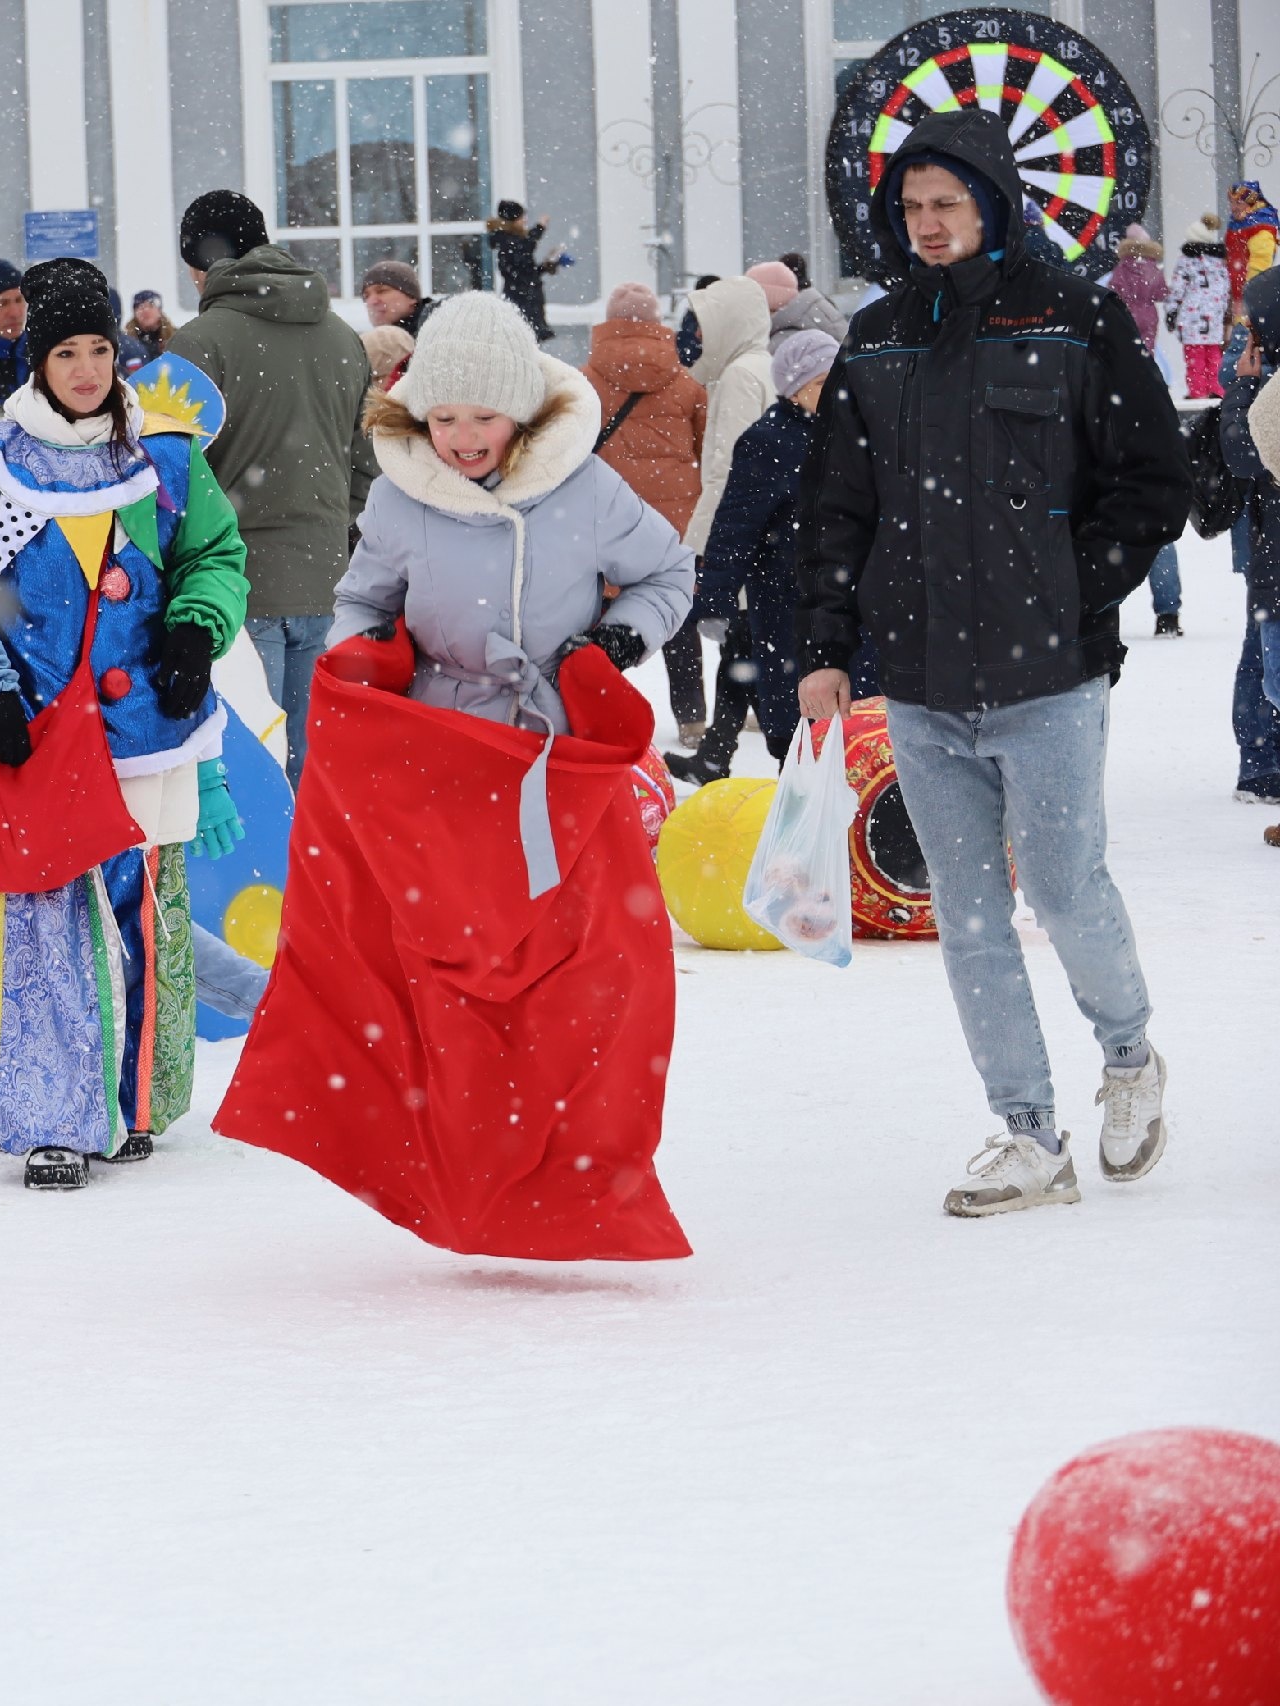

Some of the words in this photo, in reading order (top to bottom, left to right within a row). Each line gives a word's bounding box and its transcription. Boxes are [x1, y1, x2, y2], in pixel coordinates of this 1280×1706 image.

[938, 27, 952, 46] 5
[975, 20, 1000, 38] 20
[1026, 24, 1036, 42] 1
[897, 47, 920, 66] 12
[1058, 40, 1080, 59] 18
[1094, 68, 1106, 87] 4
[872, 79, 886, 99] 9
[1111, 106, 1135, 126] 13
[848, 119, 872, 136] 14
[1124, 148, 1138, 167] 6
[842, 160, 863, 177] 11
[1113, 191, 1137, 210] 10
[856, 202, 869, 221] 8
[1095, 231, 1121, 252] 15
